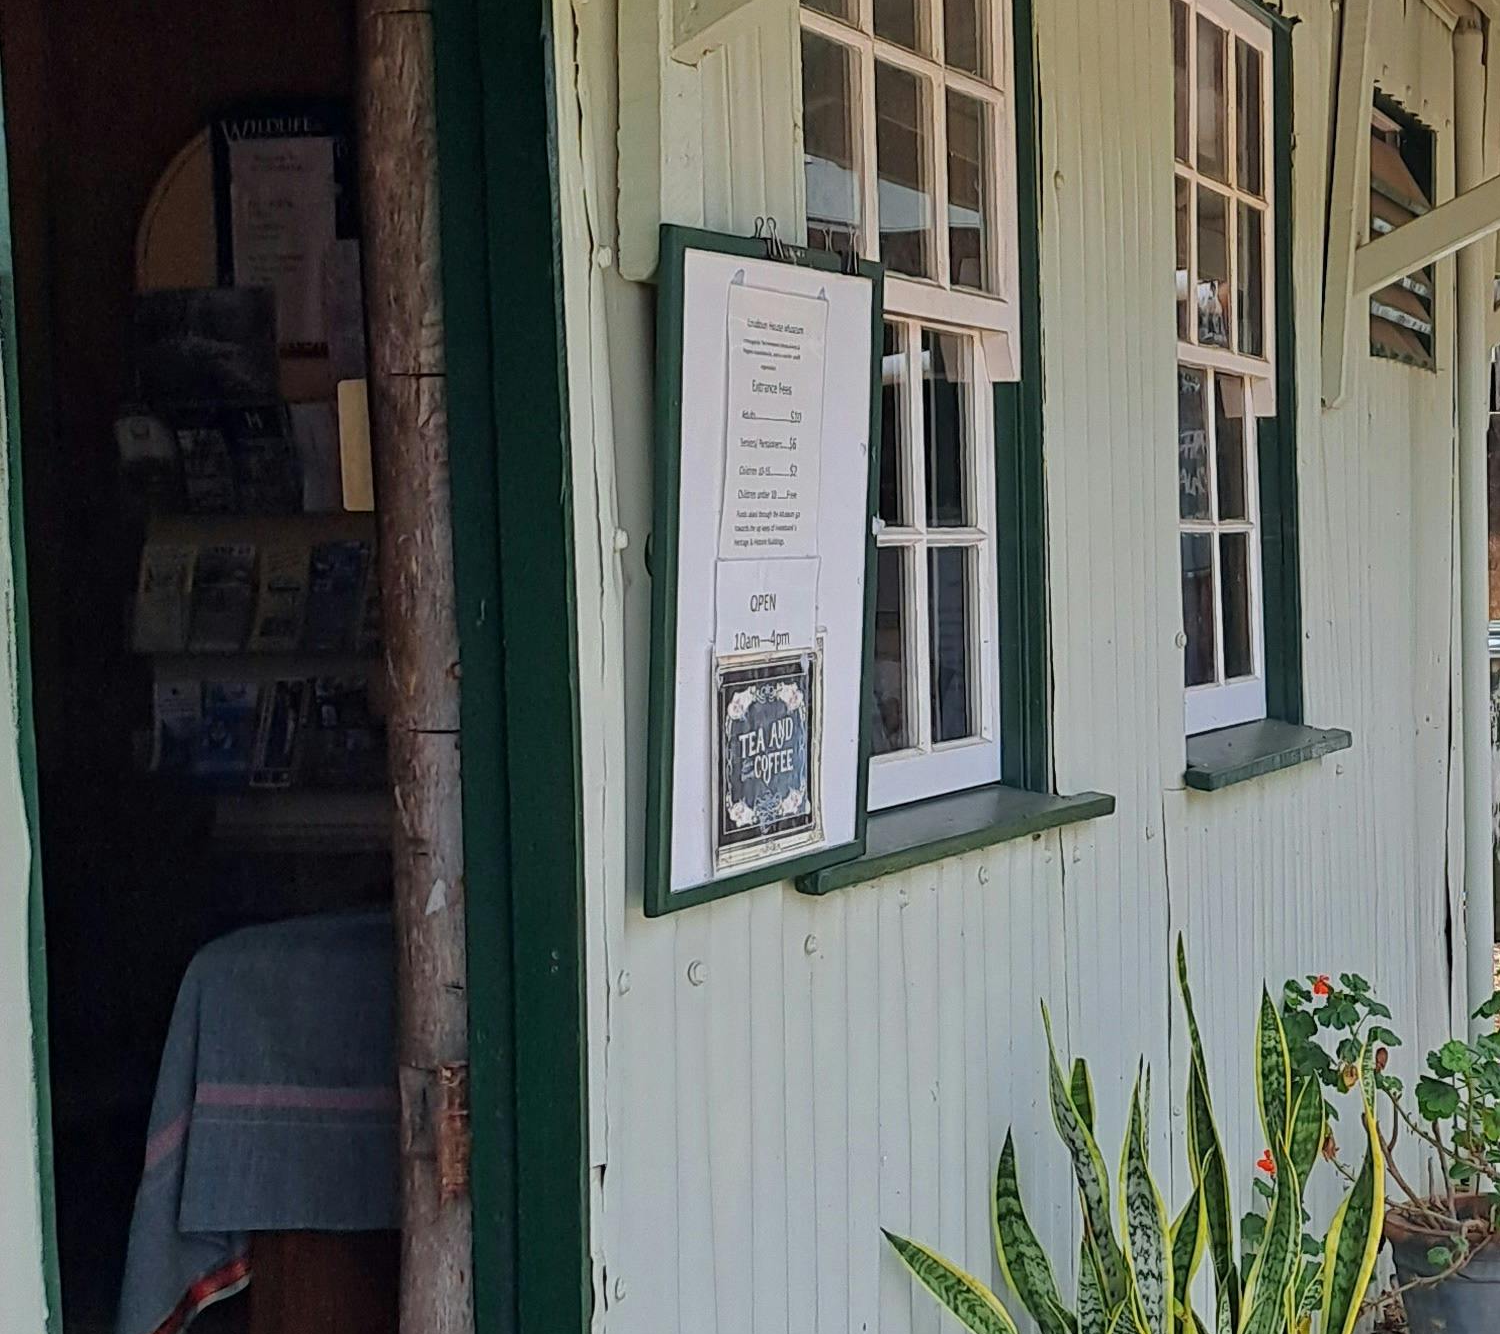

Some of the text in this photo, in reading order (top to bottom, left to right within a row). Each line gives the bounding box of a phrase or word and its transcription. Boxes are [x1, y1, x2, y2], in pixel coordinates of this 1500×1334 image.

[752, 379, 792, 395] Entrance Fees
[750, 593, 777, 612] OPEN
[738, 717, 794, 759] TEA AND
[754, 749, 794, 786] COFFEE
